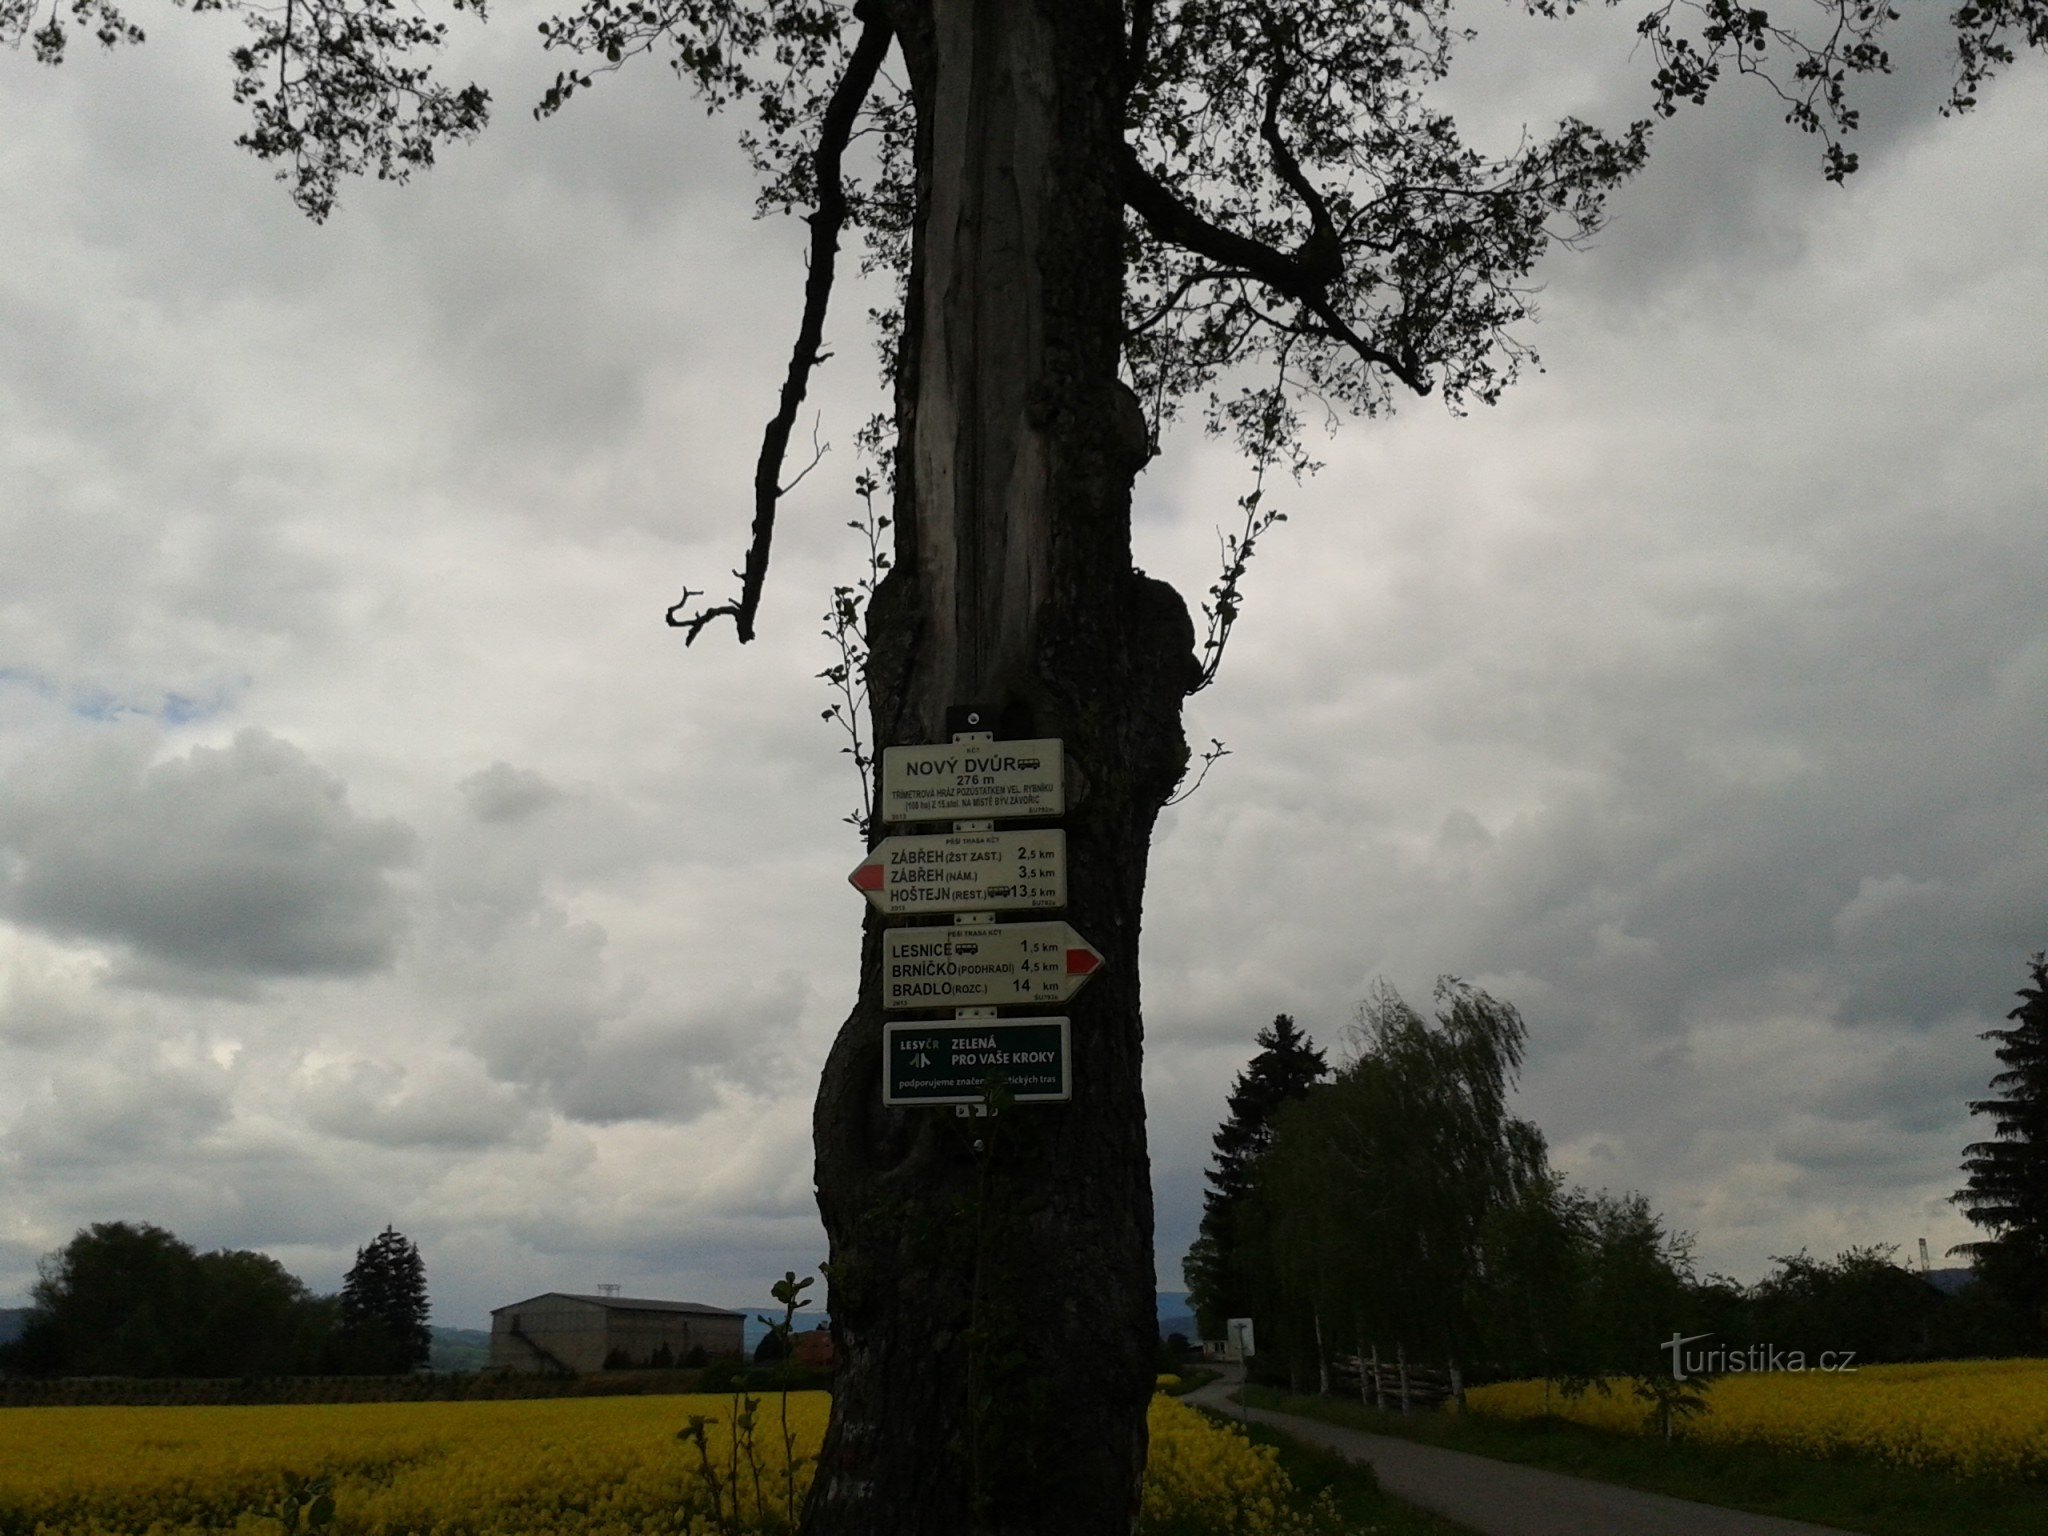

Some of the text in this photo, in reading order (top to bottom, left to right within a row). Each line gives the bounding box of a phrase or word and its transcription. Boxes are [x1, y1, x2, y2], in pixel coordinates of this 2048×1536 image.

[906, 754, 1016, 776] NOVÝ DVŮR
[957, 774, 995, 786] 276 m
[936, 785, 955, 797] HRÁZ
[962, 798, 973, 807] NA
[891, 848, 944, 865] ZÁBŘEH
[970, 851, 1002, 862] ZAST.)
[1018, 847, 1036, 860] 2,5
[1039, 850, 1055, 858] km
[891, 866, 1055, 883] ZÁBŘEH (NÁM.) 3,5 km
[890, 885, 950, 902] HOŠTEJN
[1039, 888, 1056, 896] km
[892, 939, 1058, 958] LESNICE 1,5 km
[892, 960, 957, 977] BRNÍČKO
[1021, 959, 1039, 973] 4,5
[1043, 962, 1058, 971] km
[892, 982, 952, 996] BRADLO
[1013, 979, 1031, 992] 14
[1043, 982, 1058, 990] km
[951, 1034, 997, 1050] ZELENÁ
[951, 1050, 1055, 1066] PRO VAŠE KROKY
[898, 1078, 955, 1090] podporujeme
[1039, 1075, 1056, 1083] tras
